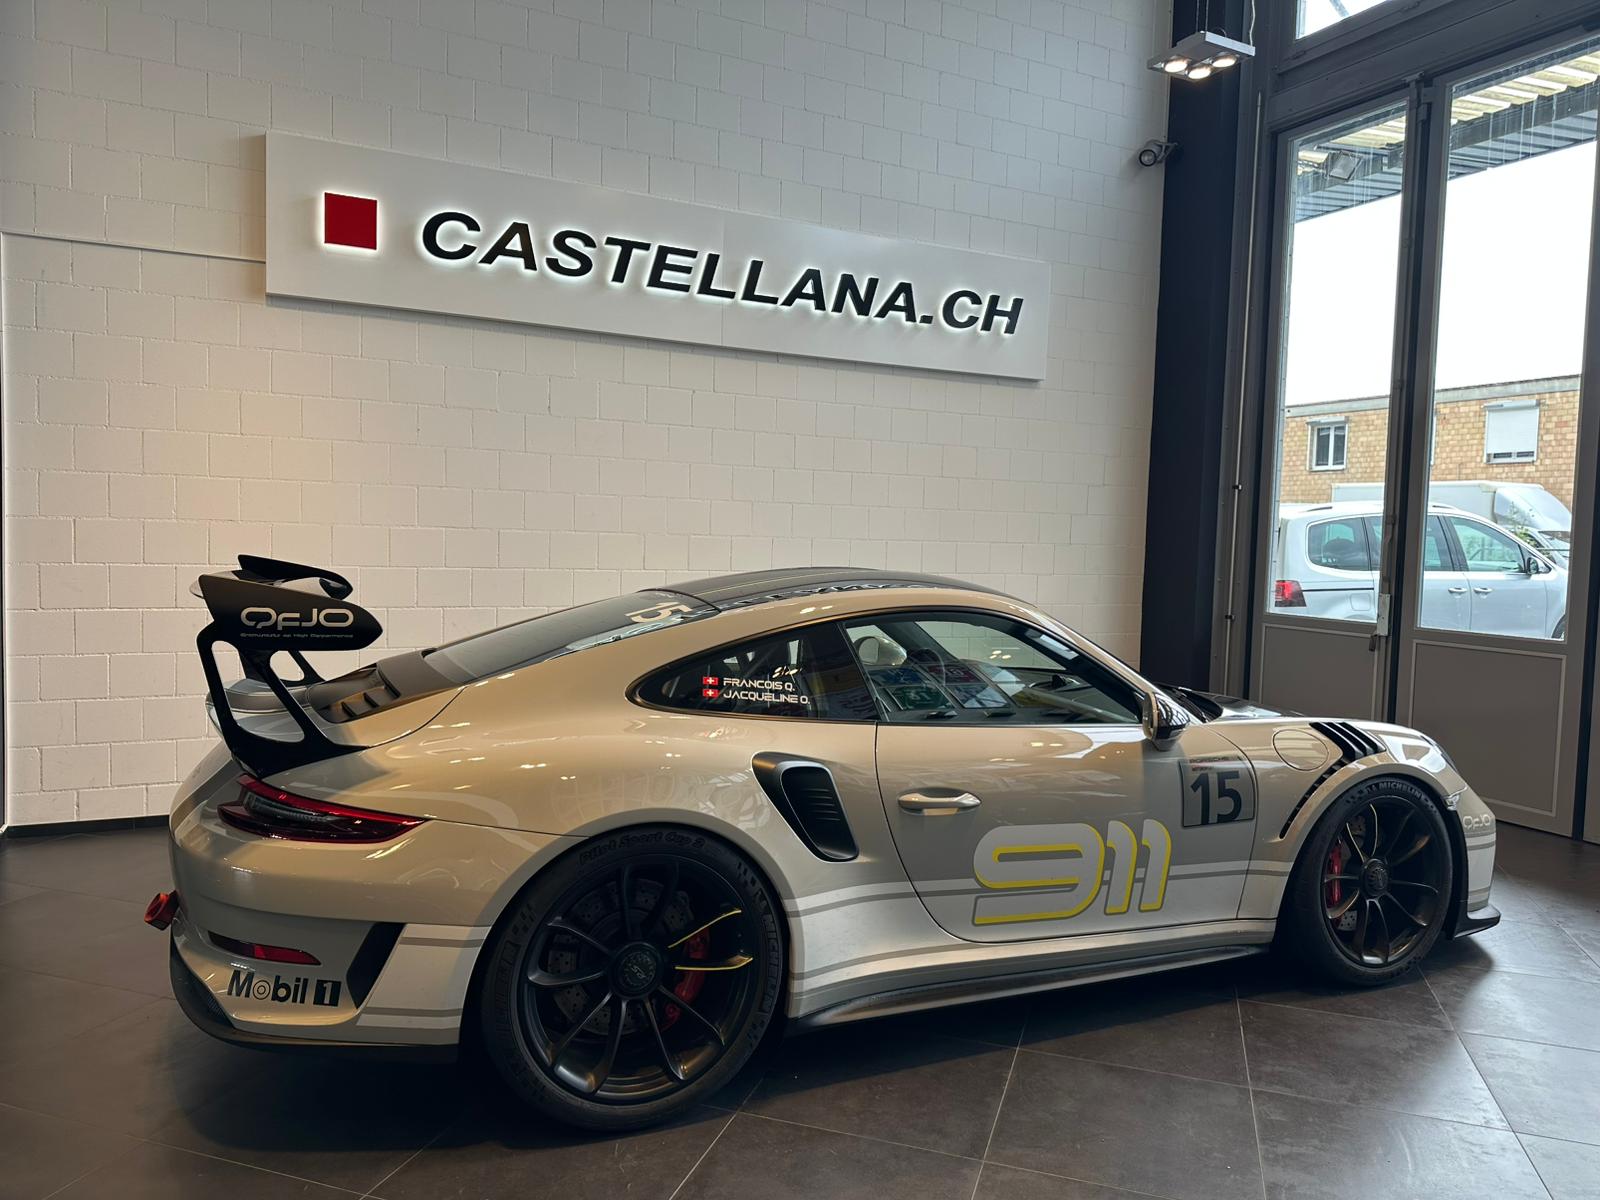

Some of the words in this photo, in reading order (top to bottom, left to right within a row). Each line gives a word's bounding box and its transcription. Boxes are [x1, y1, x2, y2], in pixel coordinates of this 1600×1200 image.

[422, 210, 1024, 335] CASTELLANA.CH
[723, 677, 783, 691] FRANCOIS
[784, 682, 796, 692] Q.
[723, 689, 799, 703] JACQUELINE
[1190, 770, 1242, 825] 15
[1379, 781, 1424, 800] MICHELIN
[972, 818, 1172, 926] 911
[226, 969, 309, 1004] Mobil
